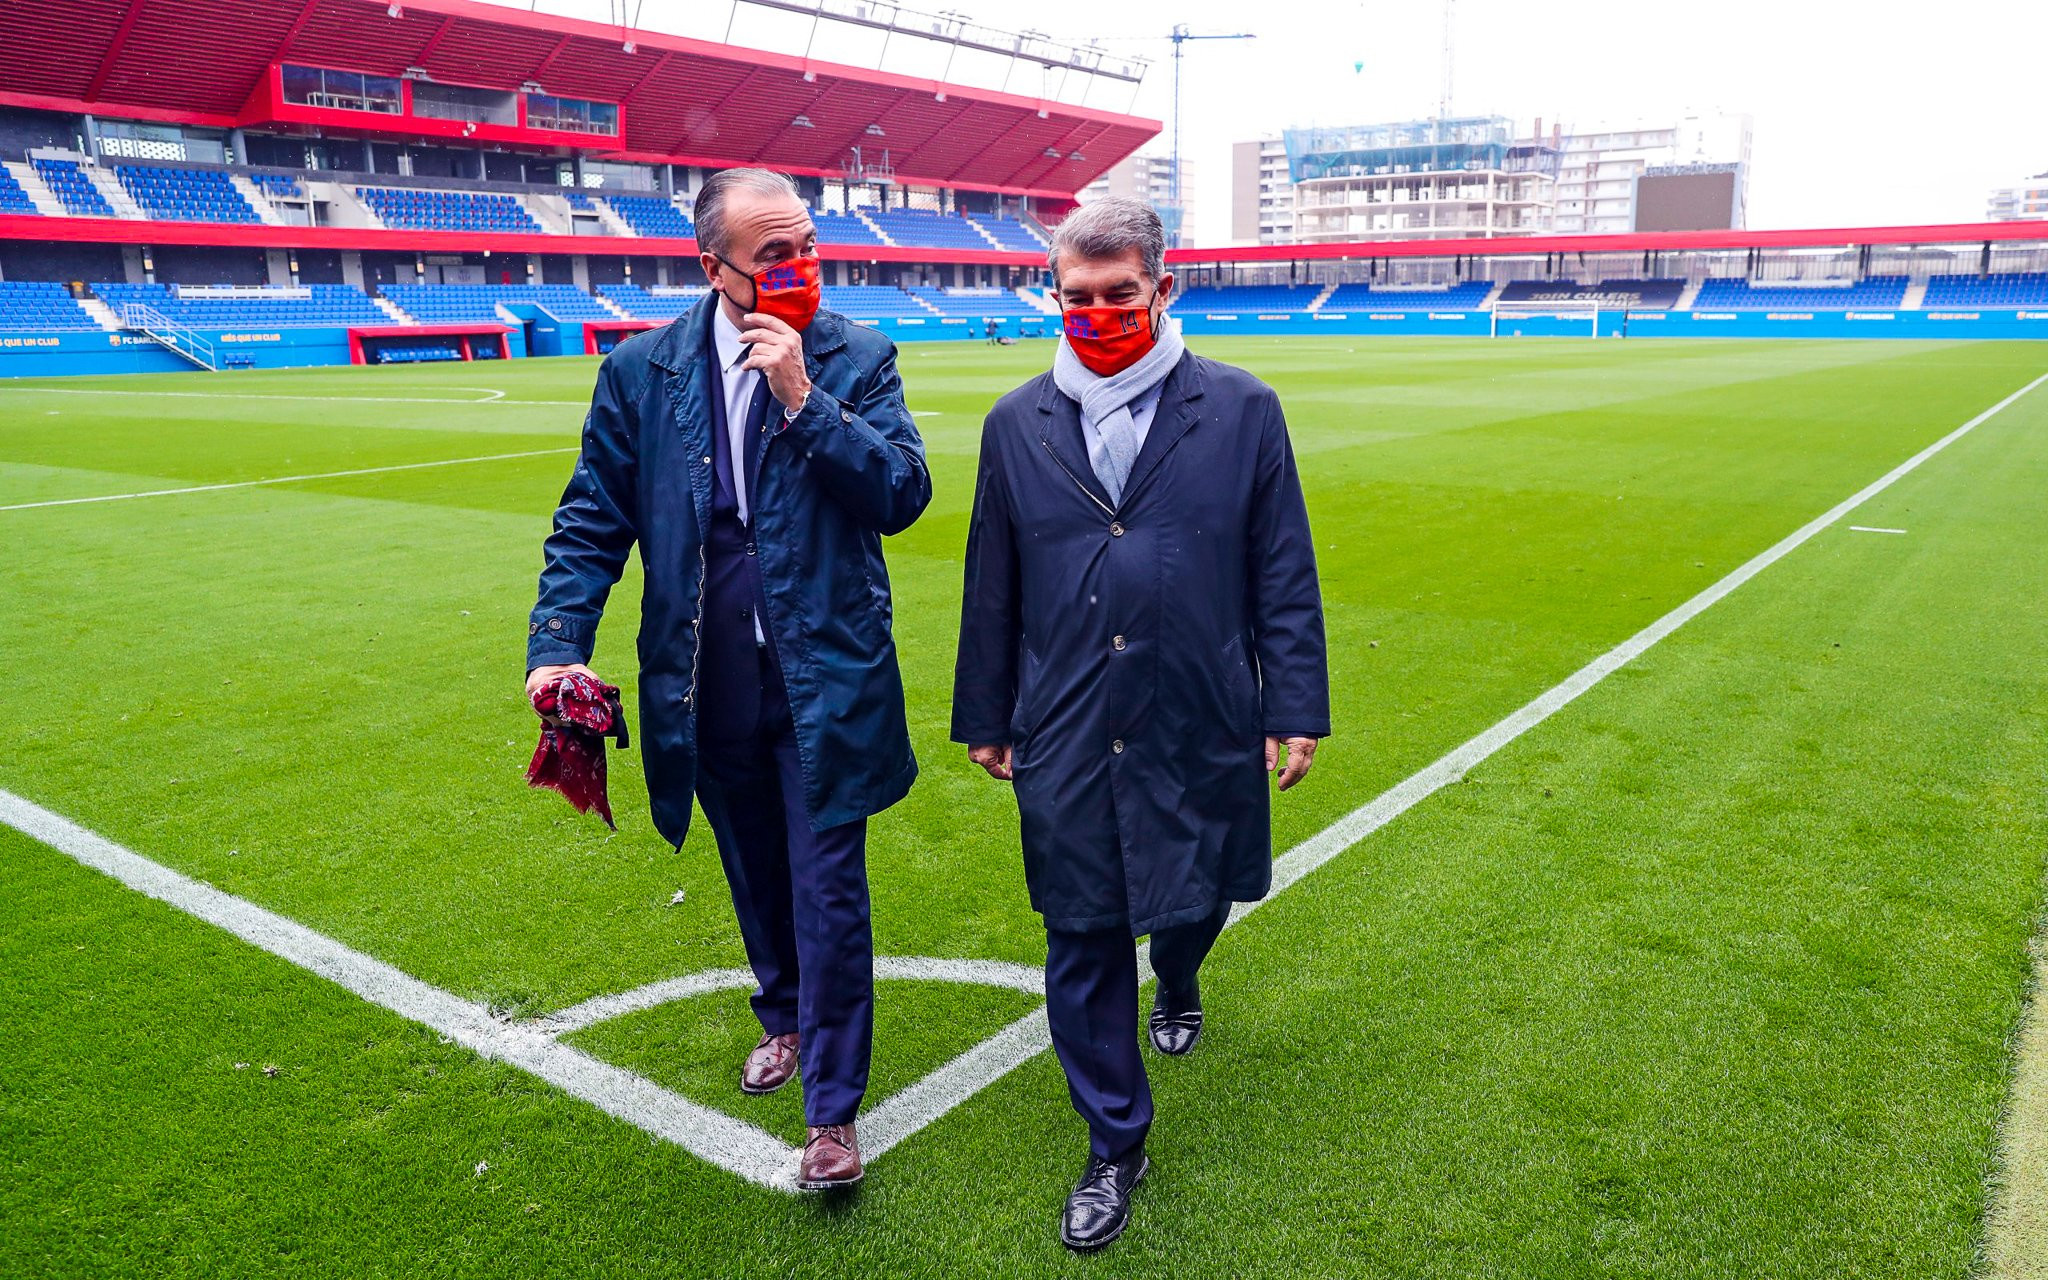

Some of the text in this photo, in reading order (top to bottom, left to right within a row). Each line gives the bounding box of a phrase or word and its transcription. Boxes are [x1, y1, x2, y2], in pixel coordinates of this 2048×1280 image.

[1528, 292, 1571, 300] JOIN
[1120, 310, 1139, 333] 14
[4, 338, 22, 347] QUE
[23, 338, 36, 346] UN
[37, 337, 60, 346] CLUB
[122, 336, 132, 344] FC
